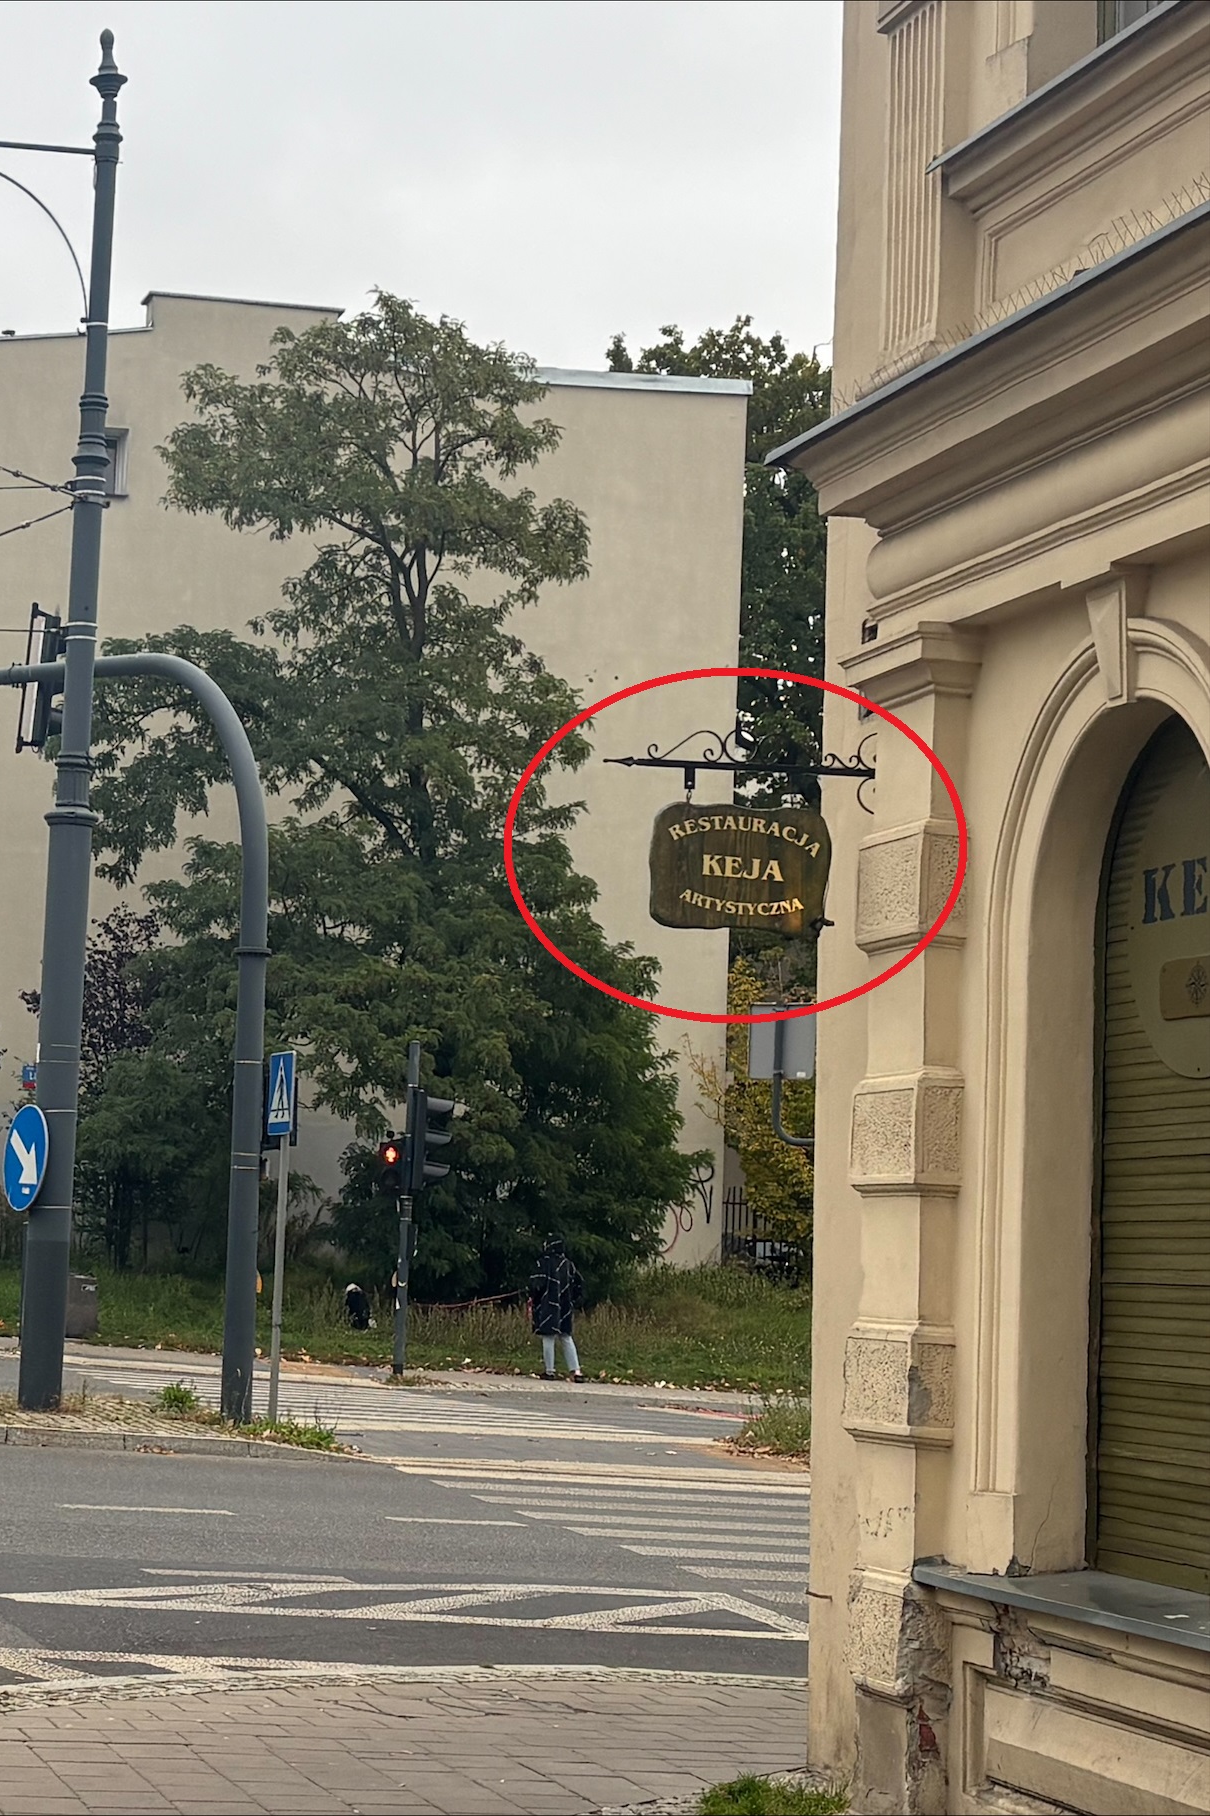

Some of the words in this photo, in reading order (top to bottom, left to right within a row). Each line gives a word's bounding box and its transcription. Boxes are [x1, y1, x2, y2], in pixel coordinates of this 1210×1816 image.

[668, 815, 821, 858] RESTAURACJA
[702, 854, 784, 882] KEJA
[679, 889, 804, 916] ARTYSTYCZNA
[1142, 856, 1208, 924] KE
